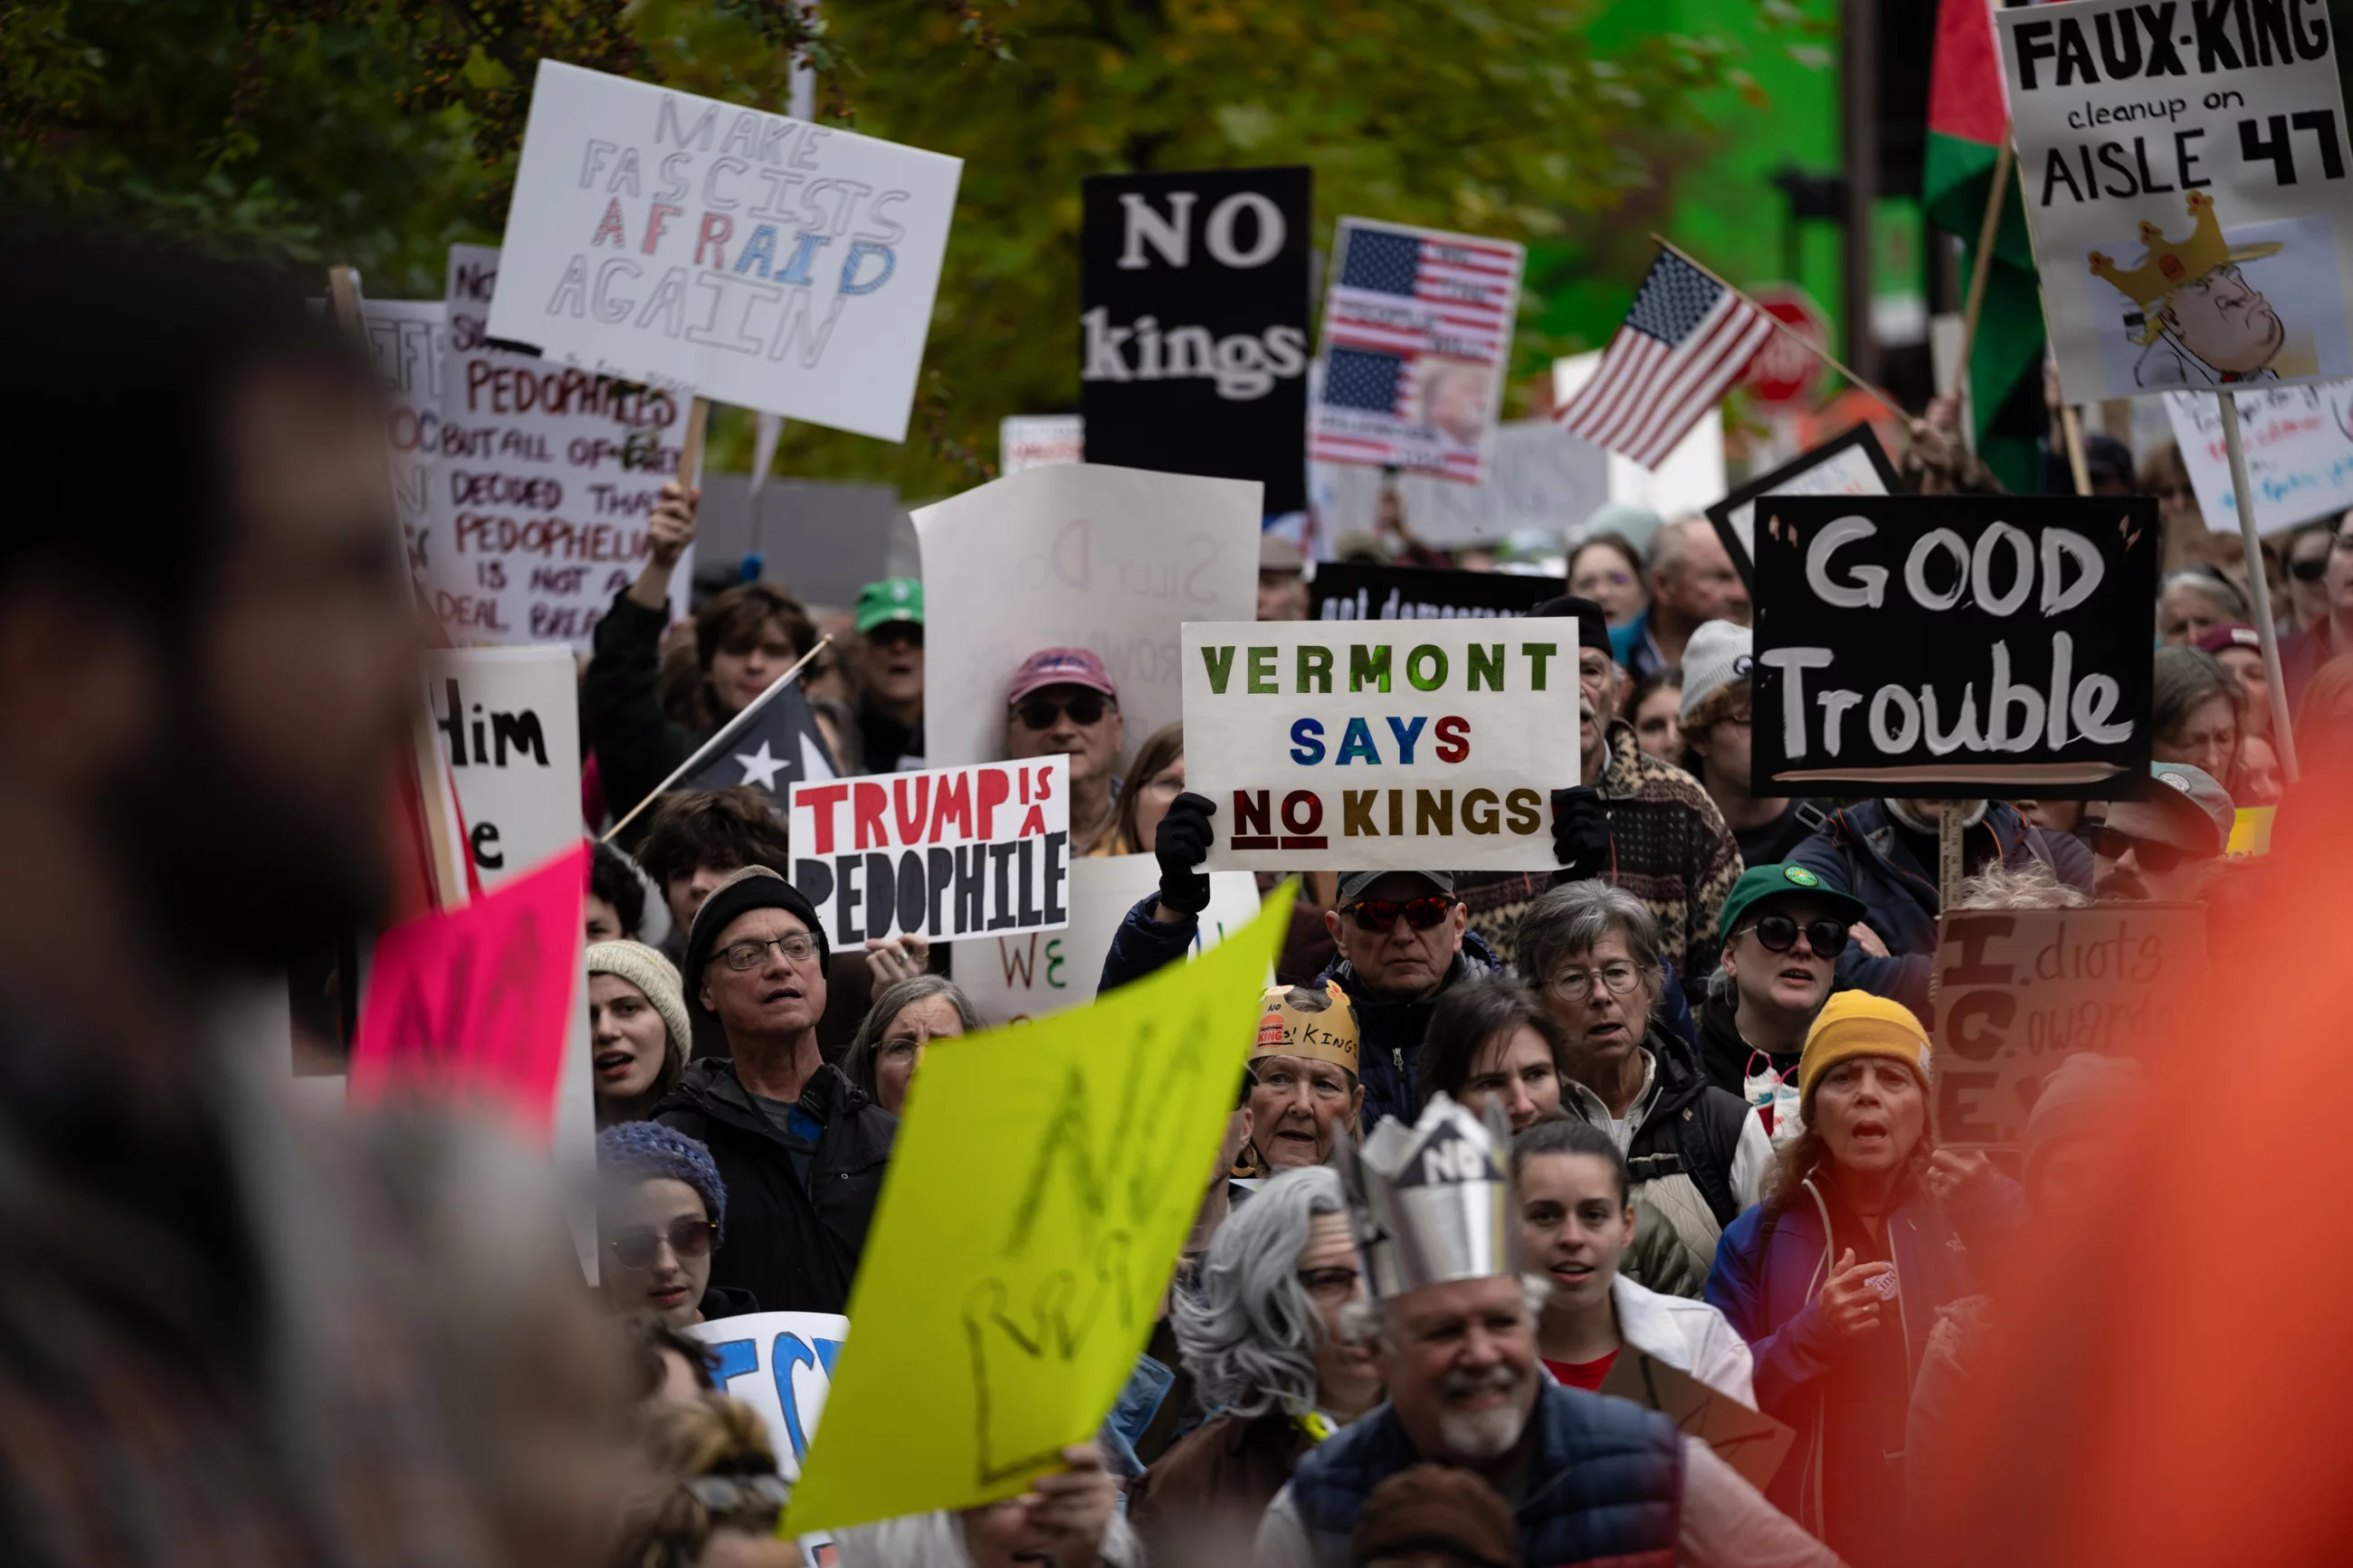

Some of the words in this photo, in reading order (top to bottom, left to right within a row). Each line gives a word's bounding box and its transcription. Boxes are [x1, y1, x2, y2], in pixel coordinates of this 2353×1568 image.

[2013, 0, 2329, 90] FAUX-KING
[653, 92, 832, 172] MAKE
[2067, 94, 2187, 129] cleanup
[2203, 90, 2244, 110] on
[2041, 128, 2212, 207] AISLE
[2238, 109, 2346, 186] 47
[578, 138, 911, 246] FASCISTS
[591, 196, 897, 296] AFRAID
[1117, 191, 1287, 270] NO
[546, 253, 847, 370] AGAIN
[1080, 305, 1309, 401] kings
[442, 421, 500, 460] BUT
[451, 469, 563, 512] DECIDED
[455, 511, 651, 562] PEDOPHELI
[477, 559, 508, 590] IS
[529, 564, 592, 595] NOT
[1201, 643, 1557, 694] VERMONT
[1758, 631, 2135, 759] Trouble
[1290, 716, 1472, 765] SAYS
[795, 768, 1010, 855] TRUMP
[1019, 765, 1053, 805] IS
[1019, 804, 1046, 838] A
[1233, 789, 1324, 836] NO
[795, 831, 1067, 946] PEDOPHILE
[999, 933, 1067, 990] WE
[1268, 1003, 1281, 1012] NO
[1422, 1136, 1484, 1183] NO
